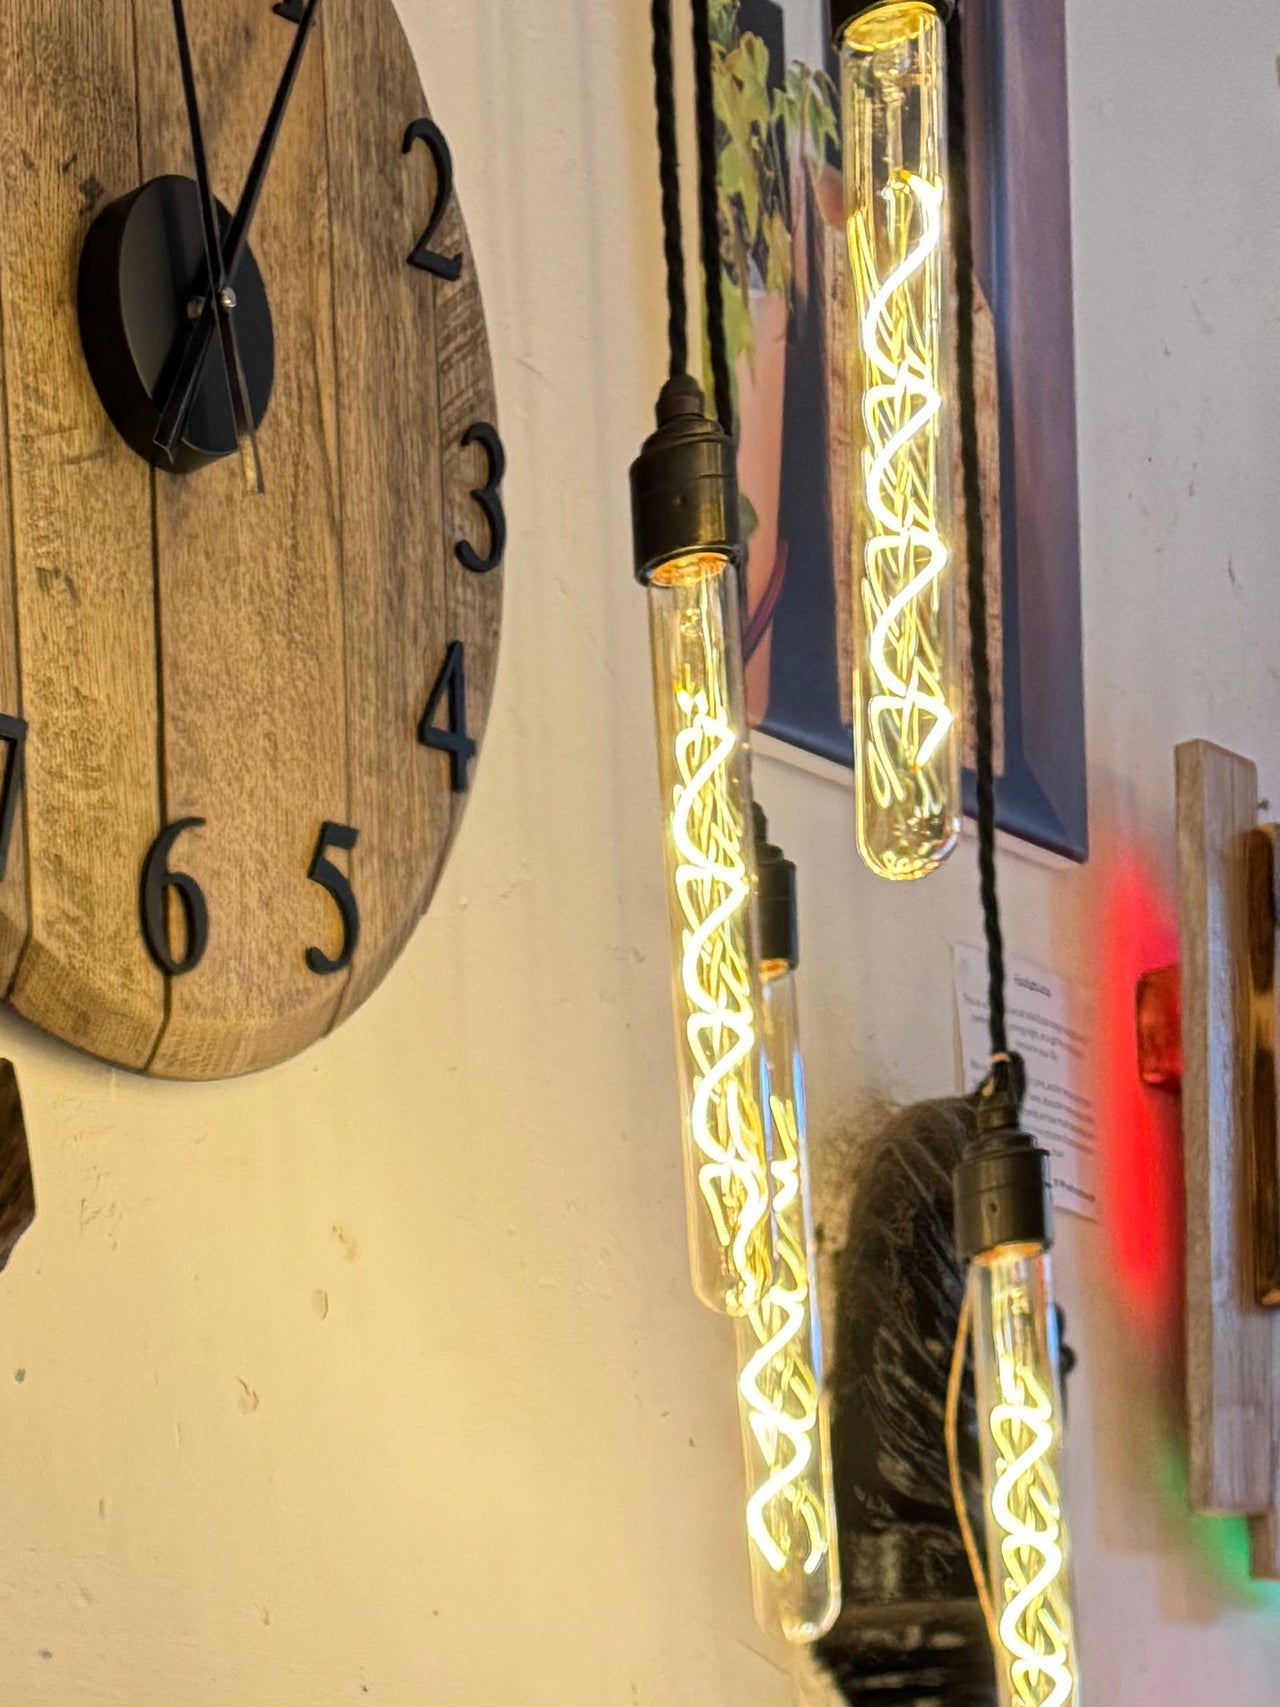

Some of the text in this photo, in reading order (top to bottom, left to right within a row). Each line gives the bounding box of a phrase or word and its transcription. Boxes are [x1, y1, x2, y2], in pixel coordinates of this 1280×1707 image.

[400, 118, 463, 282] 2
[454, 421, 507, 573] 3
[417, 640, 476, 792] 4
[138, 818, 212, 976] 6
[304, 820, 361, 976] 5
